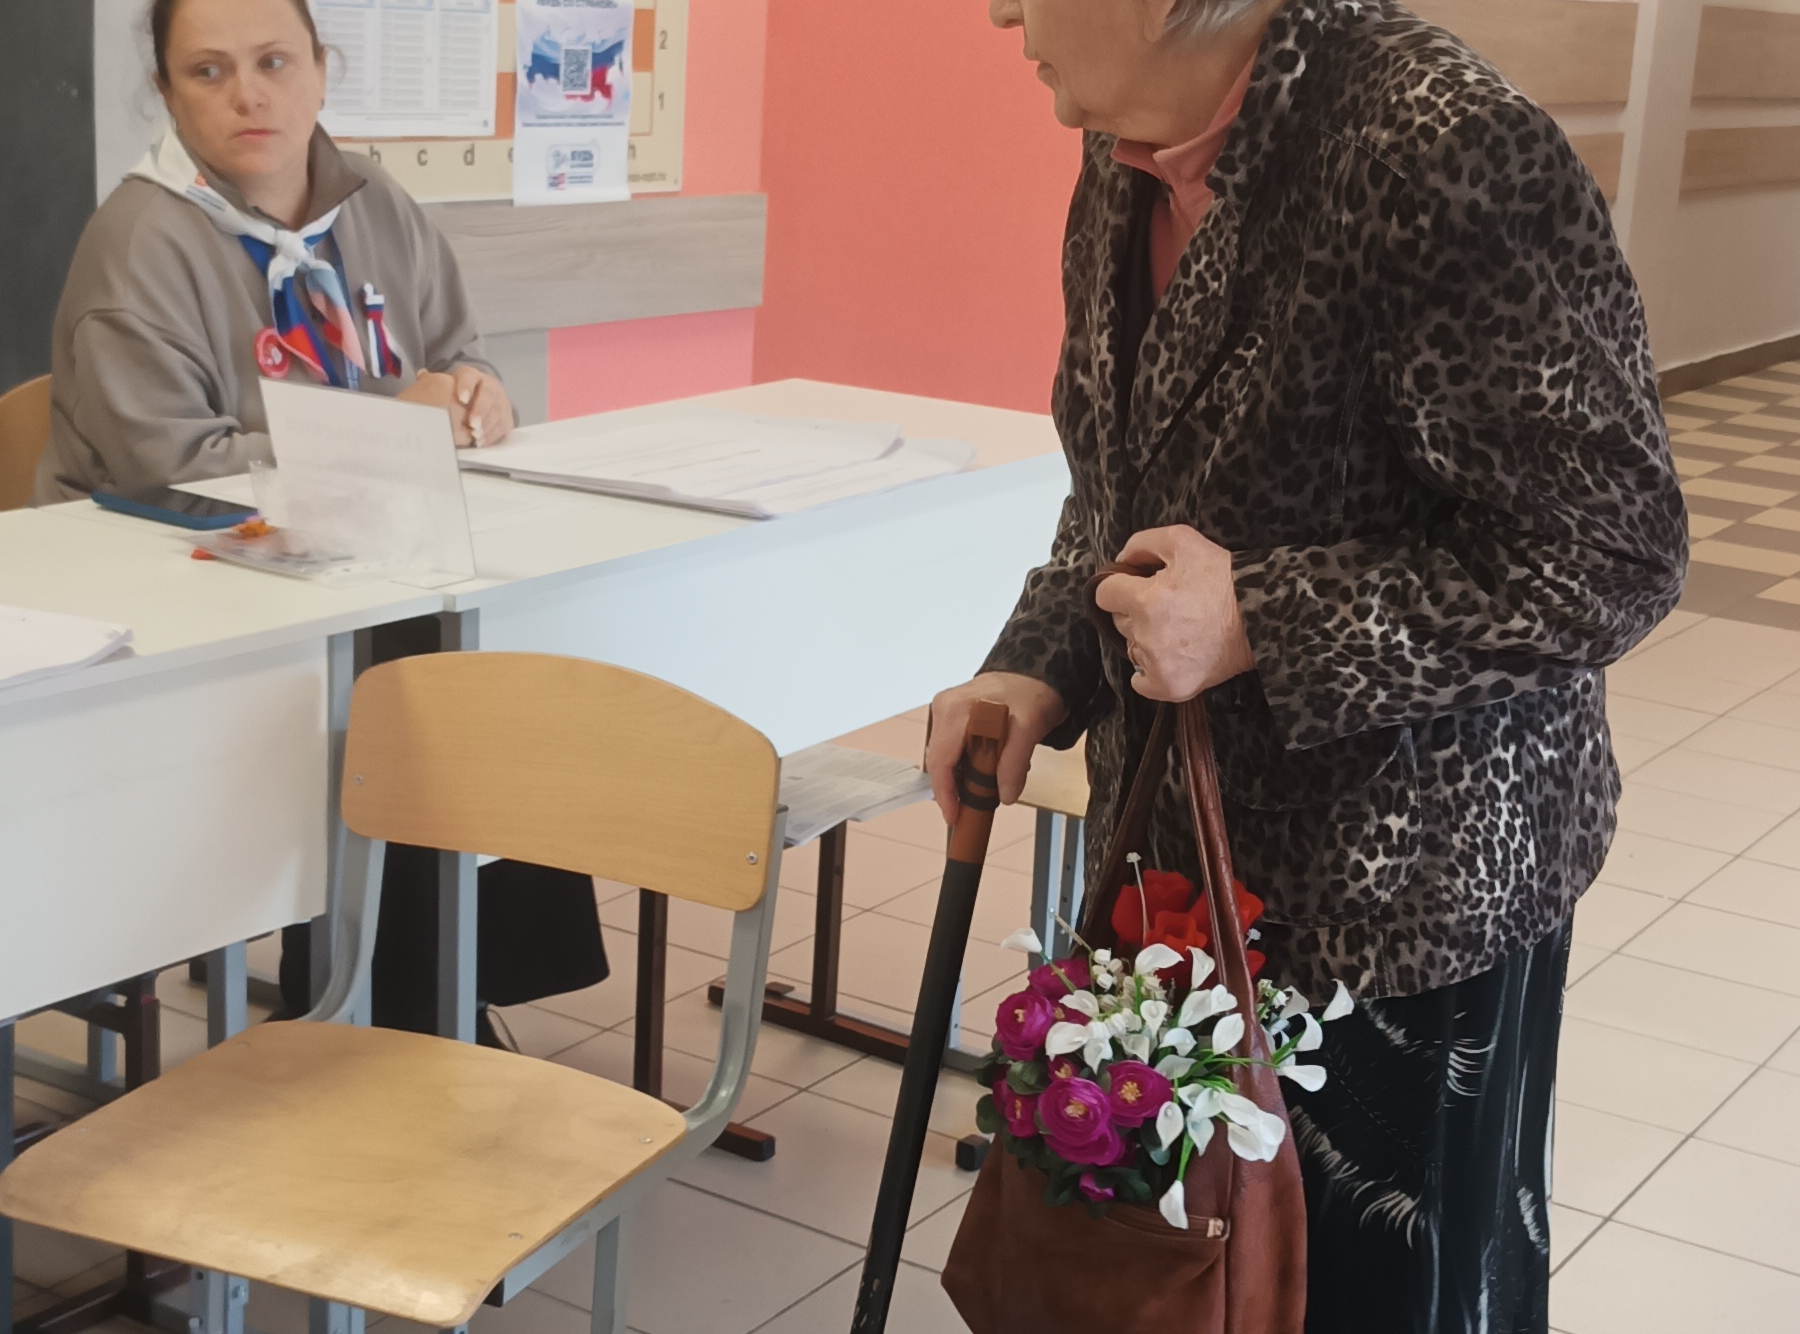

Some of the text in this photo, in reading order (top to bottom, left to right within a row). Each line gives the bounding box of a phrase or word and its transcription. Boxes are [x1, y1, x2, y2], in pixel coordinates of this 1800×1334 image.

[659, 29, 668, 50] 2
[658, 91, 665, 111] 1
[416, 148, 428, 167] c
[463, 141, 475, 166] d
